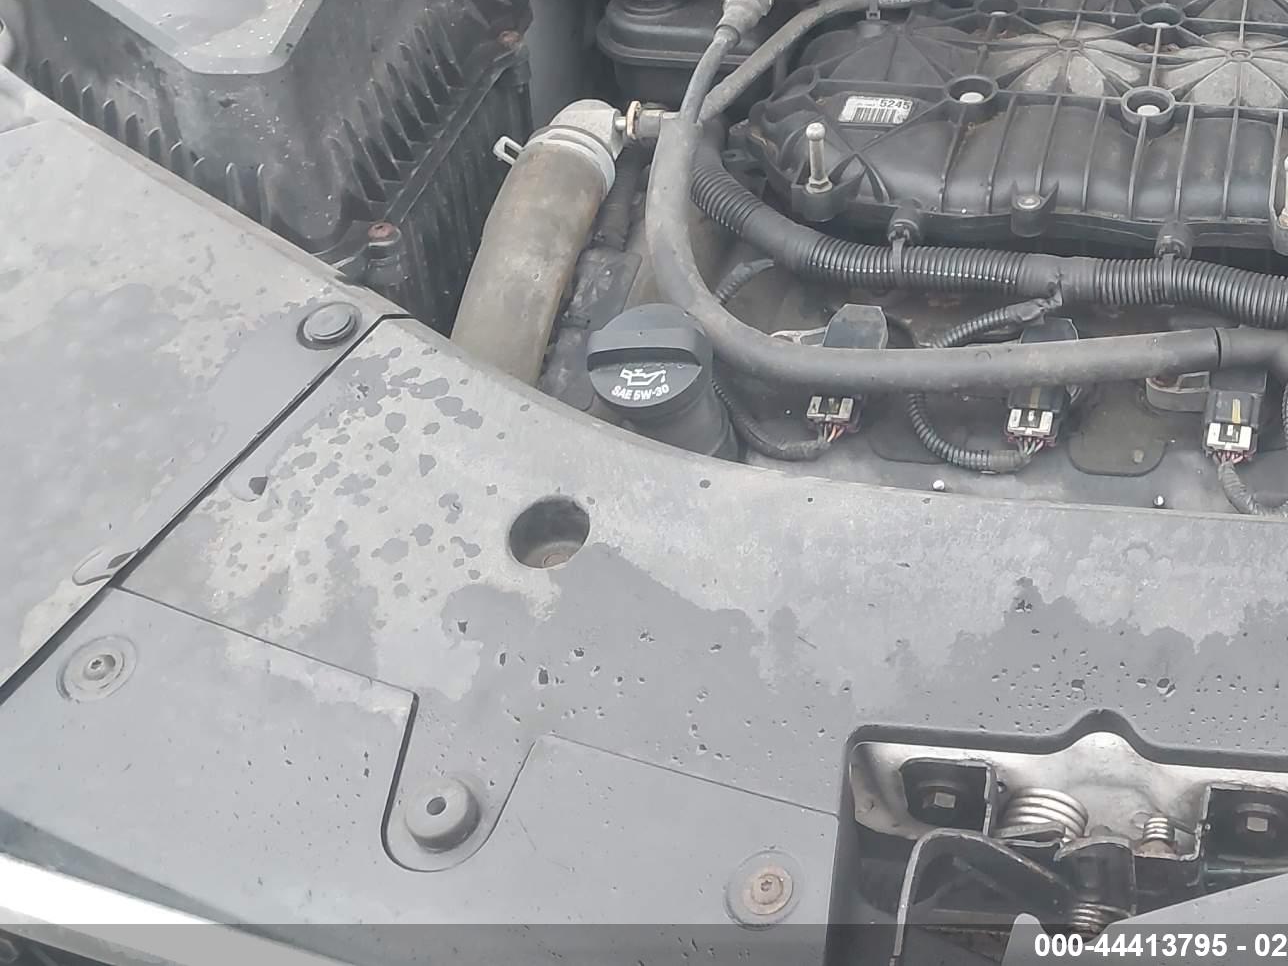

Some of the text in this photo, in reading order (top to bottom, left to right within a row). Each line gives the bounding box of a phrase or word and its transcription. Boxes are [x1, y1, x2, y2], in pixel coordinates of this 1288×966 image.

[879, 99, 911, 110] 5245
[611, 384, 669, 400] SAE 5W-30
